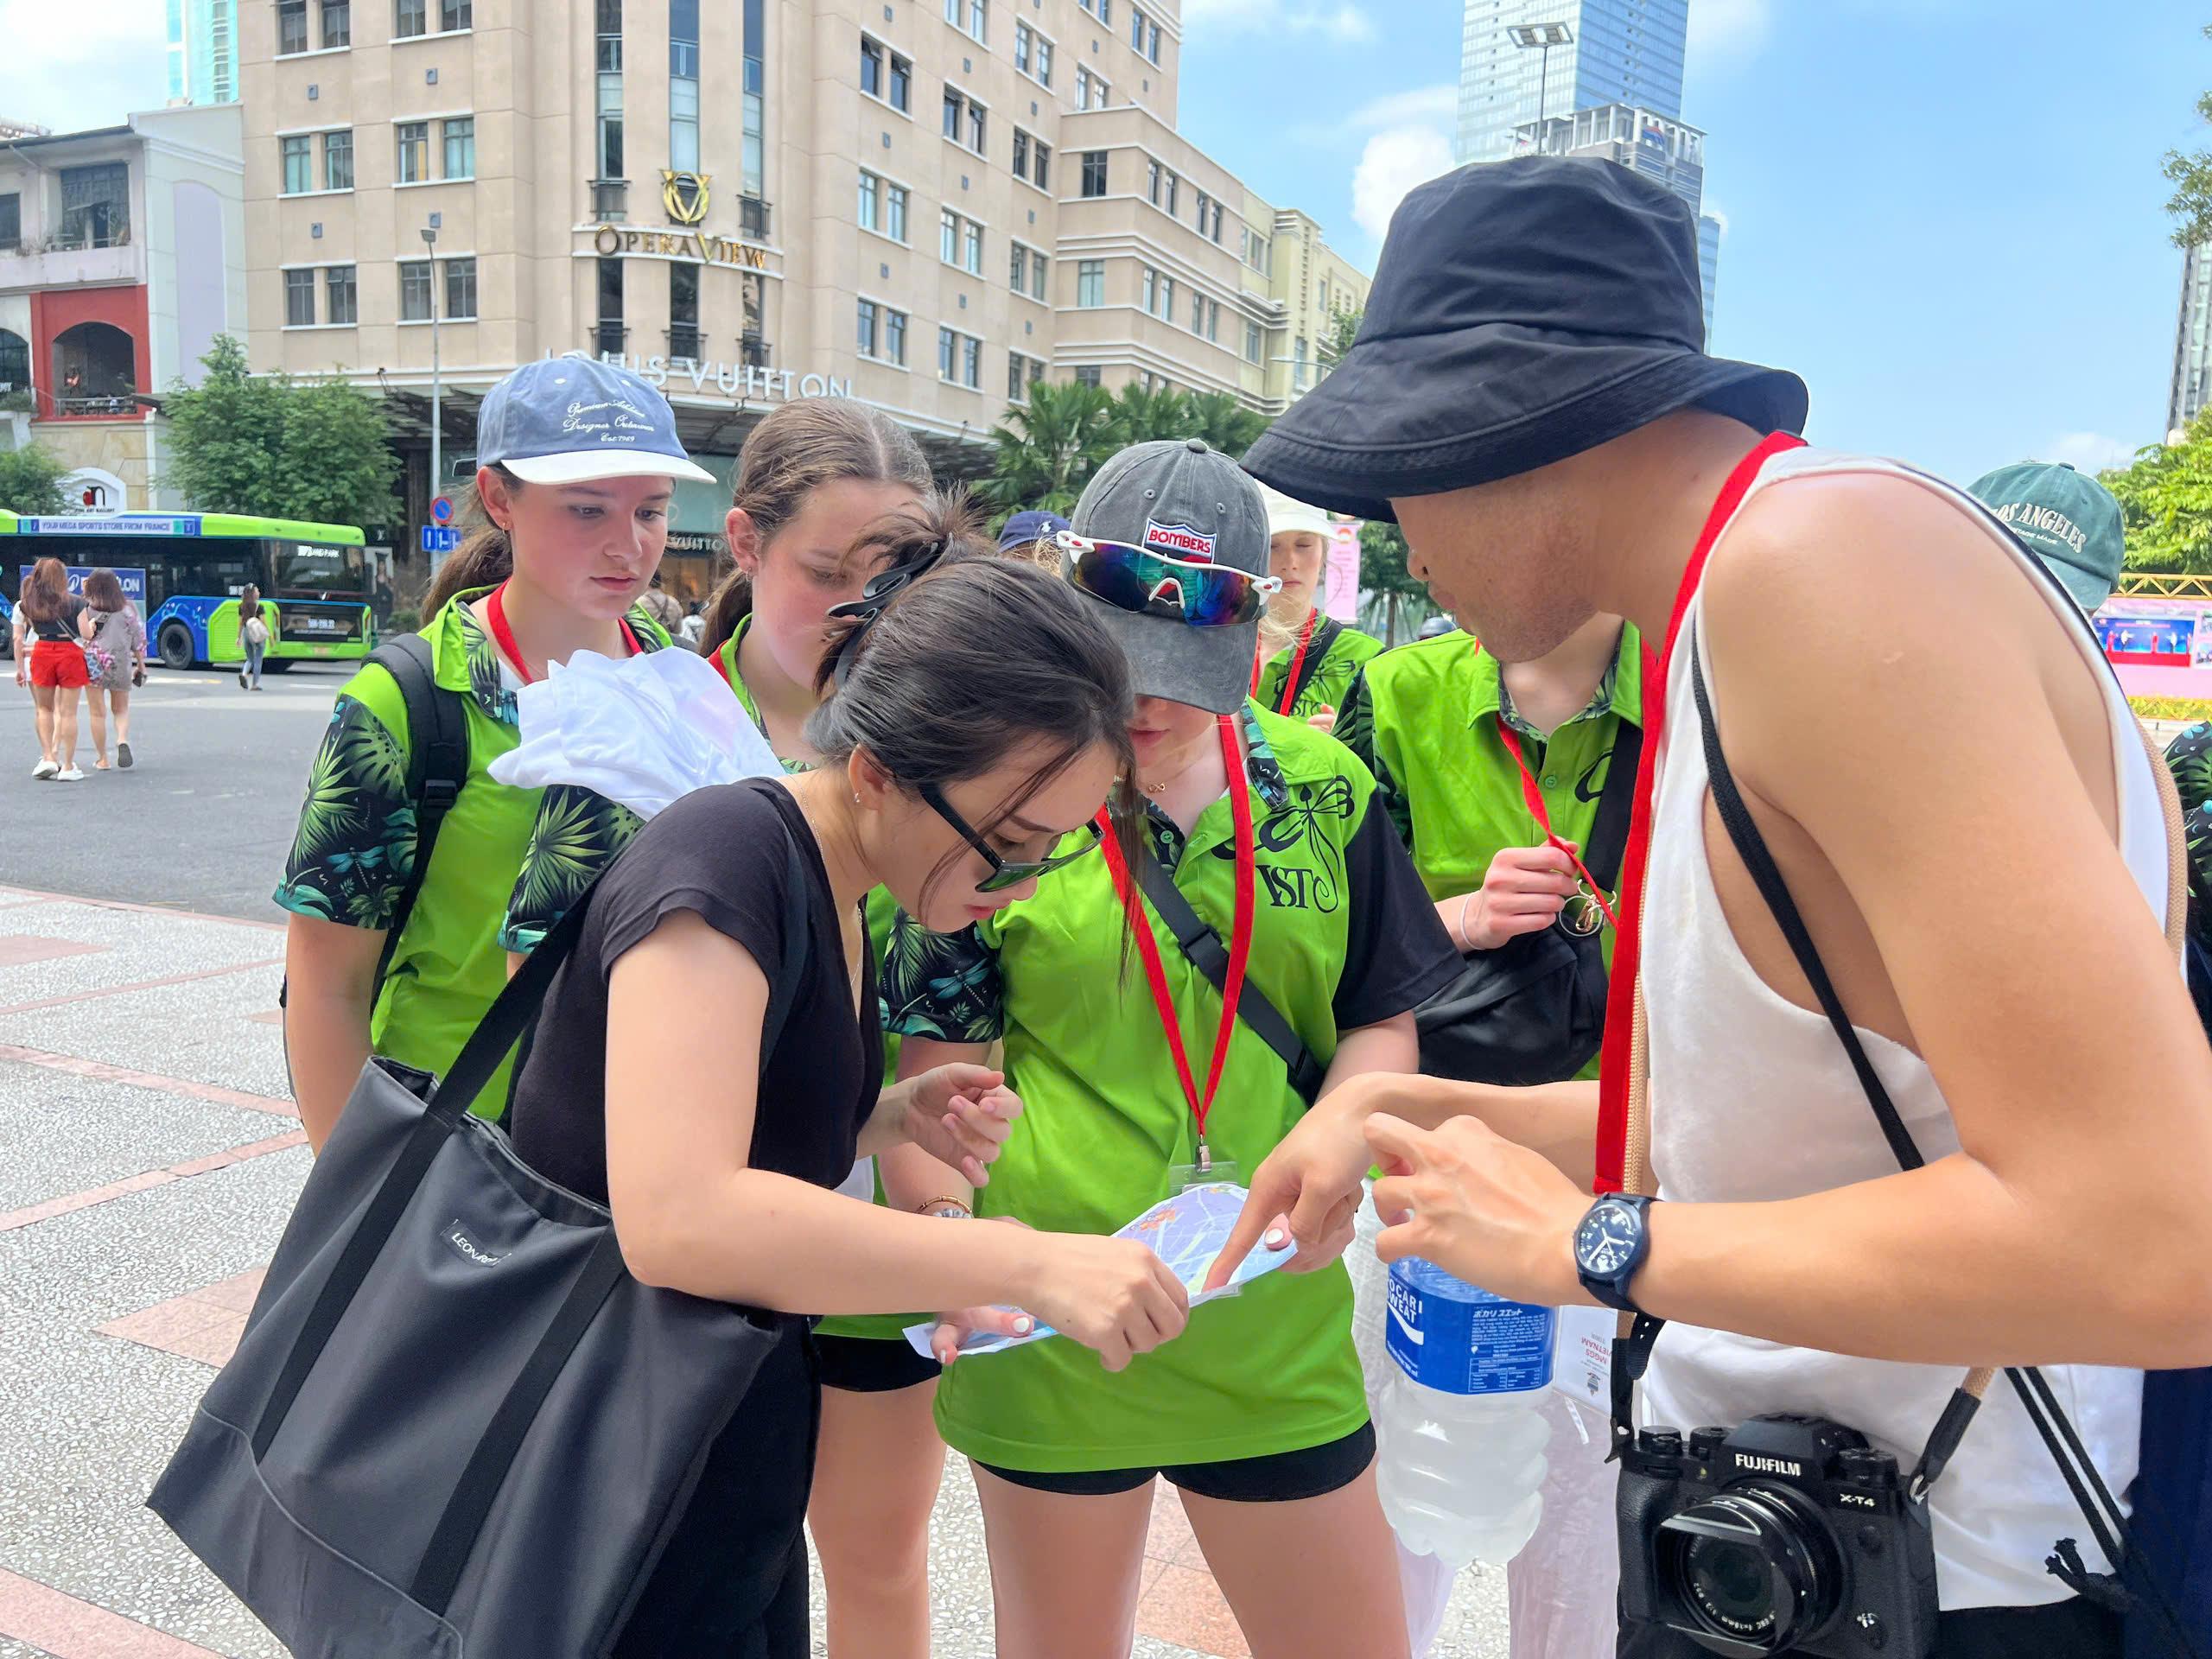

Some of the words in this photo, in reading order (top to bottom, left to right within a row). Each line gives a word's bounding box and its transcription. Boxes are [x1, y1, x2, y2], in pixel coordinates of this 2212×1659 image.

[686, 358, 853, 399] VUITTON
[42, 521, 59, 530] YOUR
[78, 522, 103, 531] SPORTS
[104, 522, 123, 531] STORE
[144, 522, 170, 531] FRANCE
[1992, 502, 2020, 523] OS
[2016, 503, 2087, 553] ANGELES
[1148, 529, 1211, 554] BOMBERS
[1388, 1278, 1423, 1314] OCARI
[1388, 1290, 1417, 1324] WEAT
[1735, 1453, 1802, 1477] FUJIFILM
[1840, 1493, 1876, 1508] X-T4
